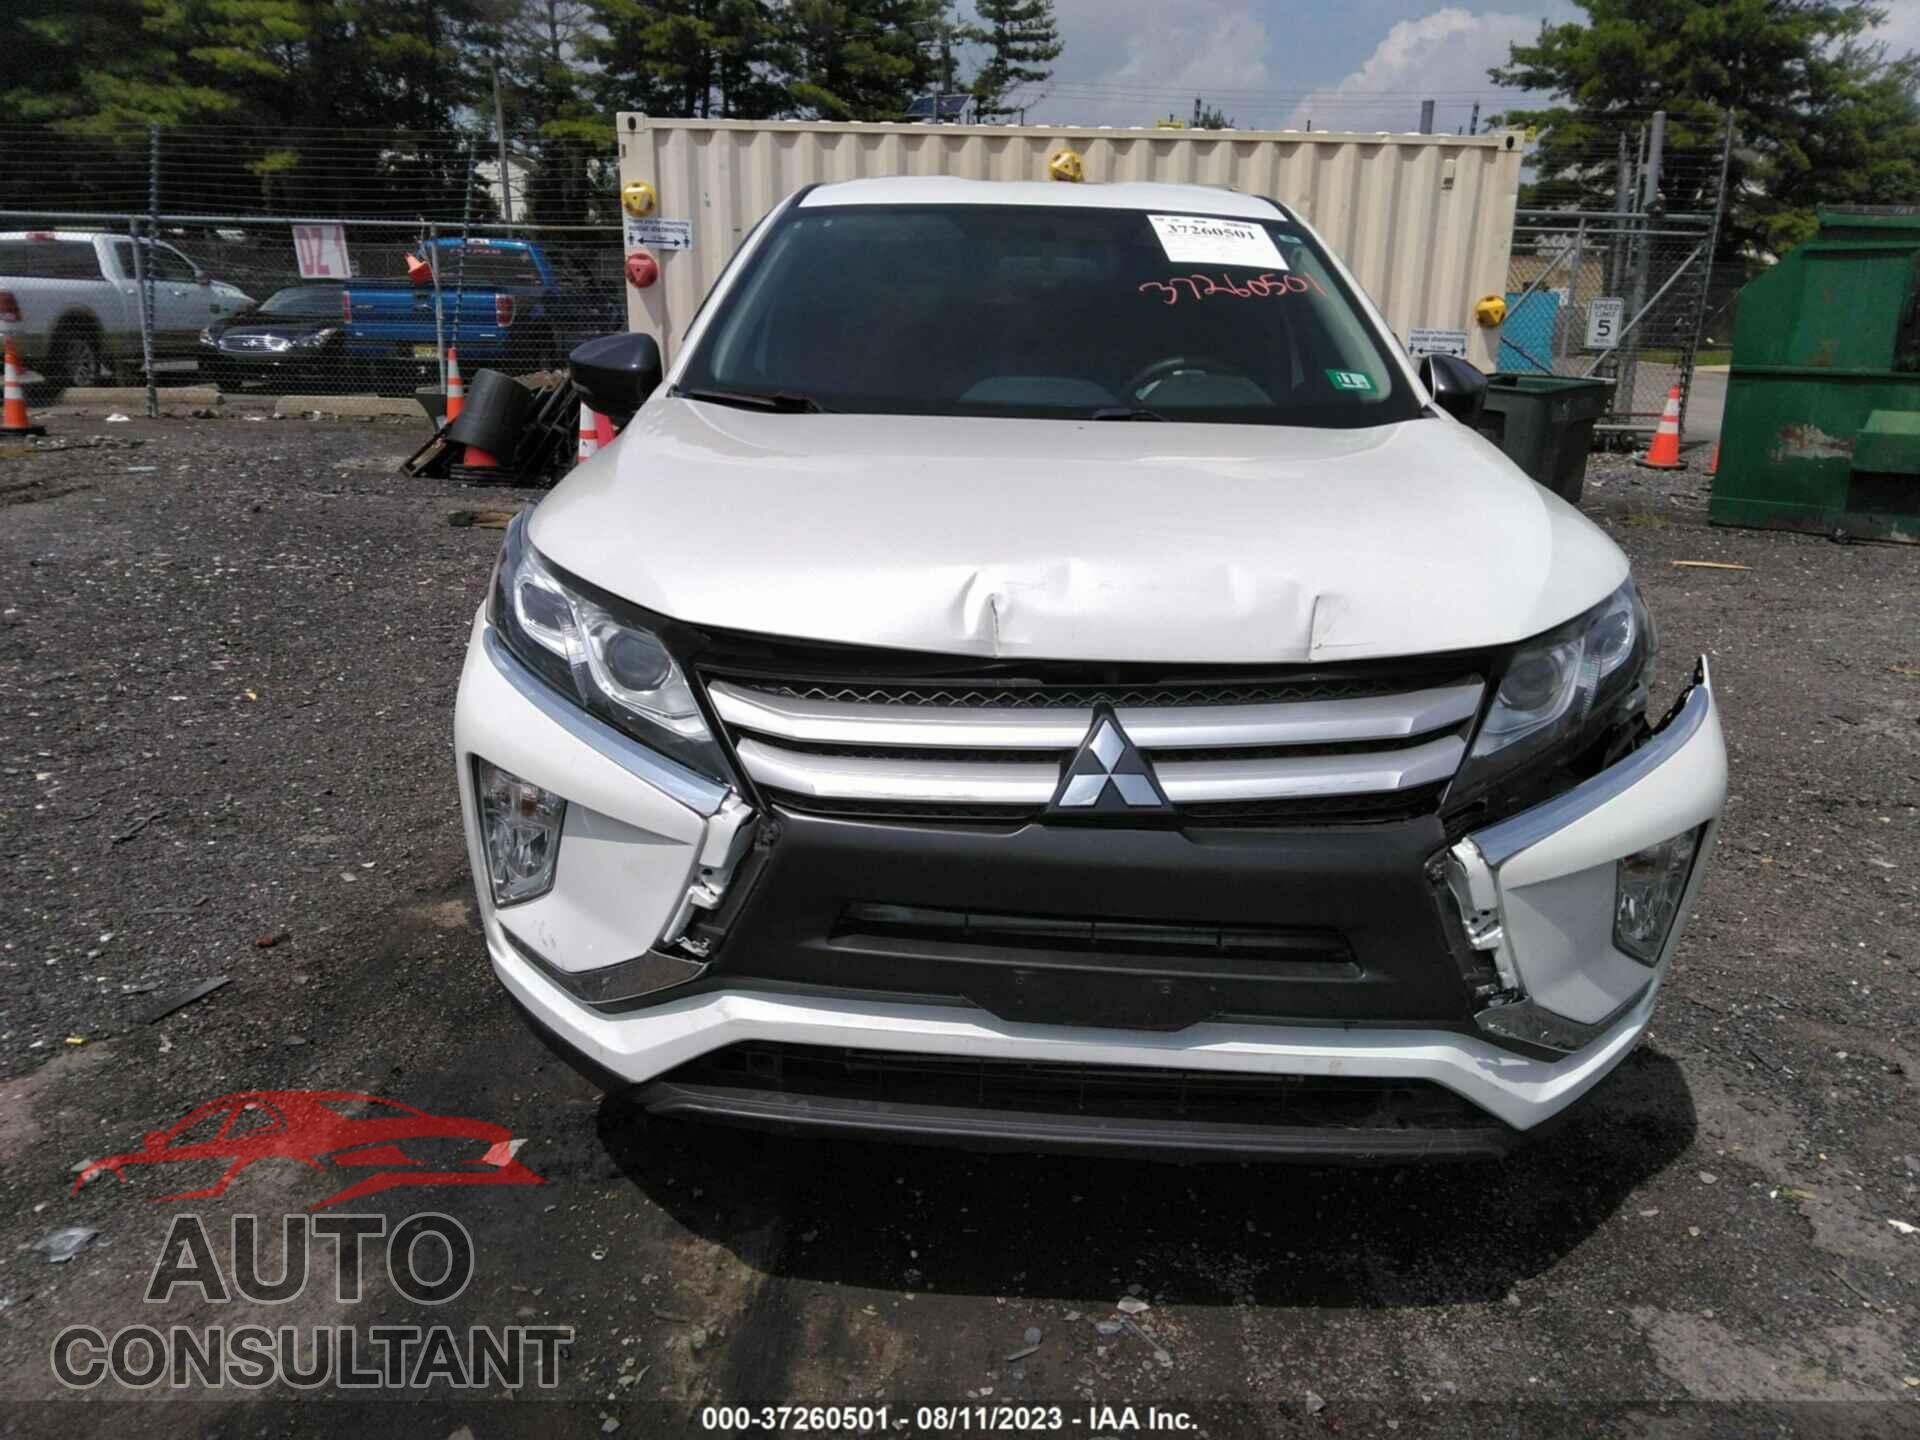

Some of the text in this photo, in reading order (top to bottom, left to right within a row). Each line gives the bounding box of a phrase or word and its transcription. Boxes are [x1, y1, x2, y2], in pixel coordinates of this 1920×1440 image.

[1168, 223, 1256, 240] 37260501
[1139, 272, 1327, 304] 37260501
[1597, 319, 1611, 337] 5
